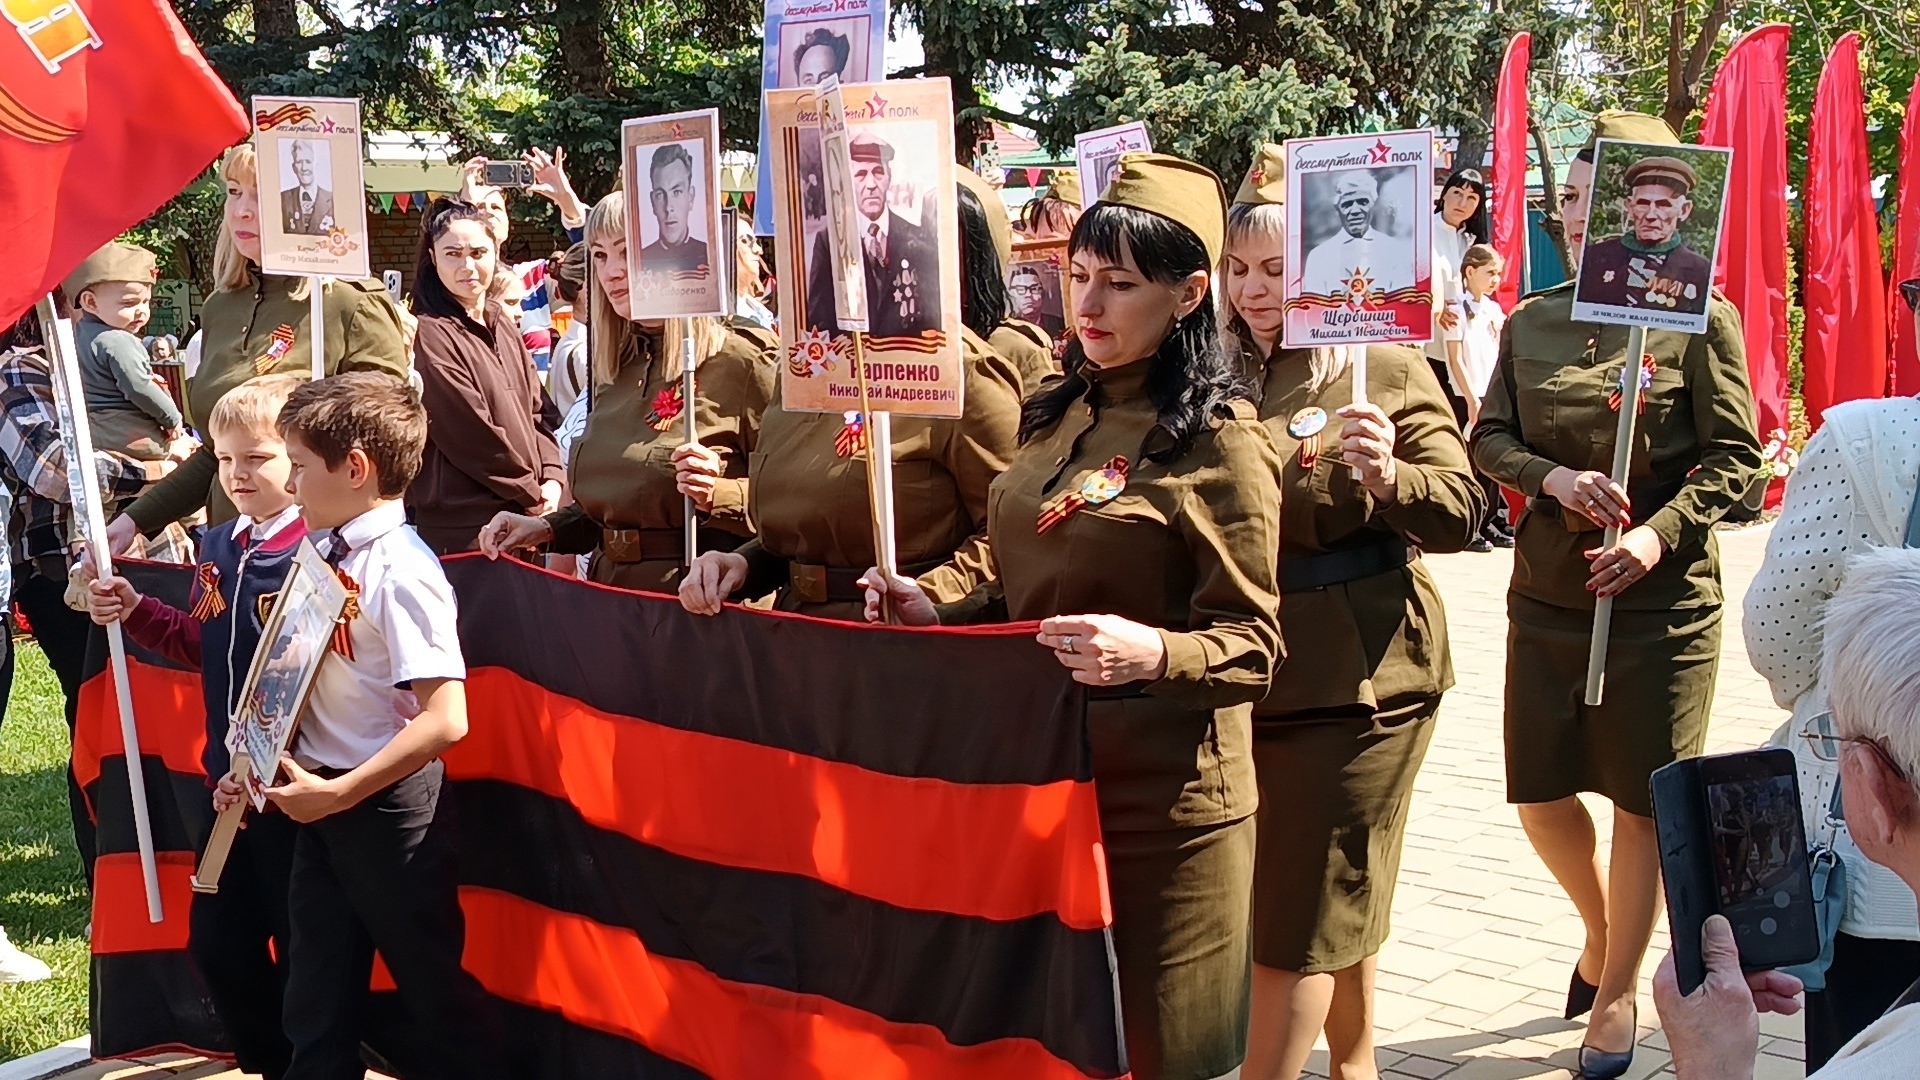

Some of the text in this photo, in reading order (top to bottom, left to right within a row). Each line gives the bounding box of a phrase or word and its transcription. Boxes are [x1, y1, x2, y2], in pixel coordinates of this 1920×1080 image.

[888, 106, 919, 117] полк
[1391, 151, 1423, 163] полк
[1322, 309, 1394, 326] Щербинин
[1309, 325, 1408, 340] Михаил Иванович
[829, 383, 955, 401] Никоай Андреевич
